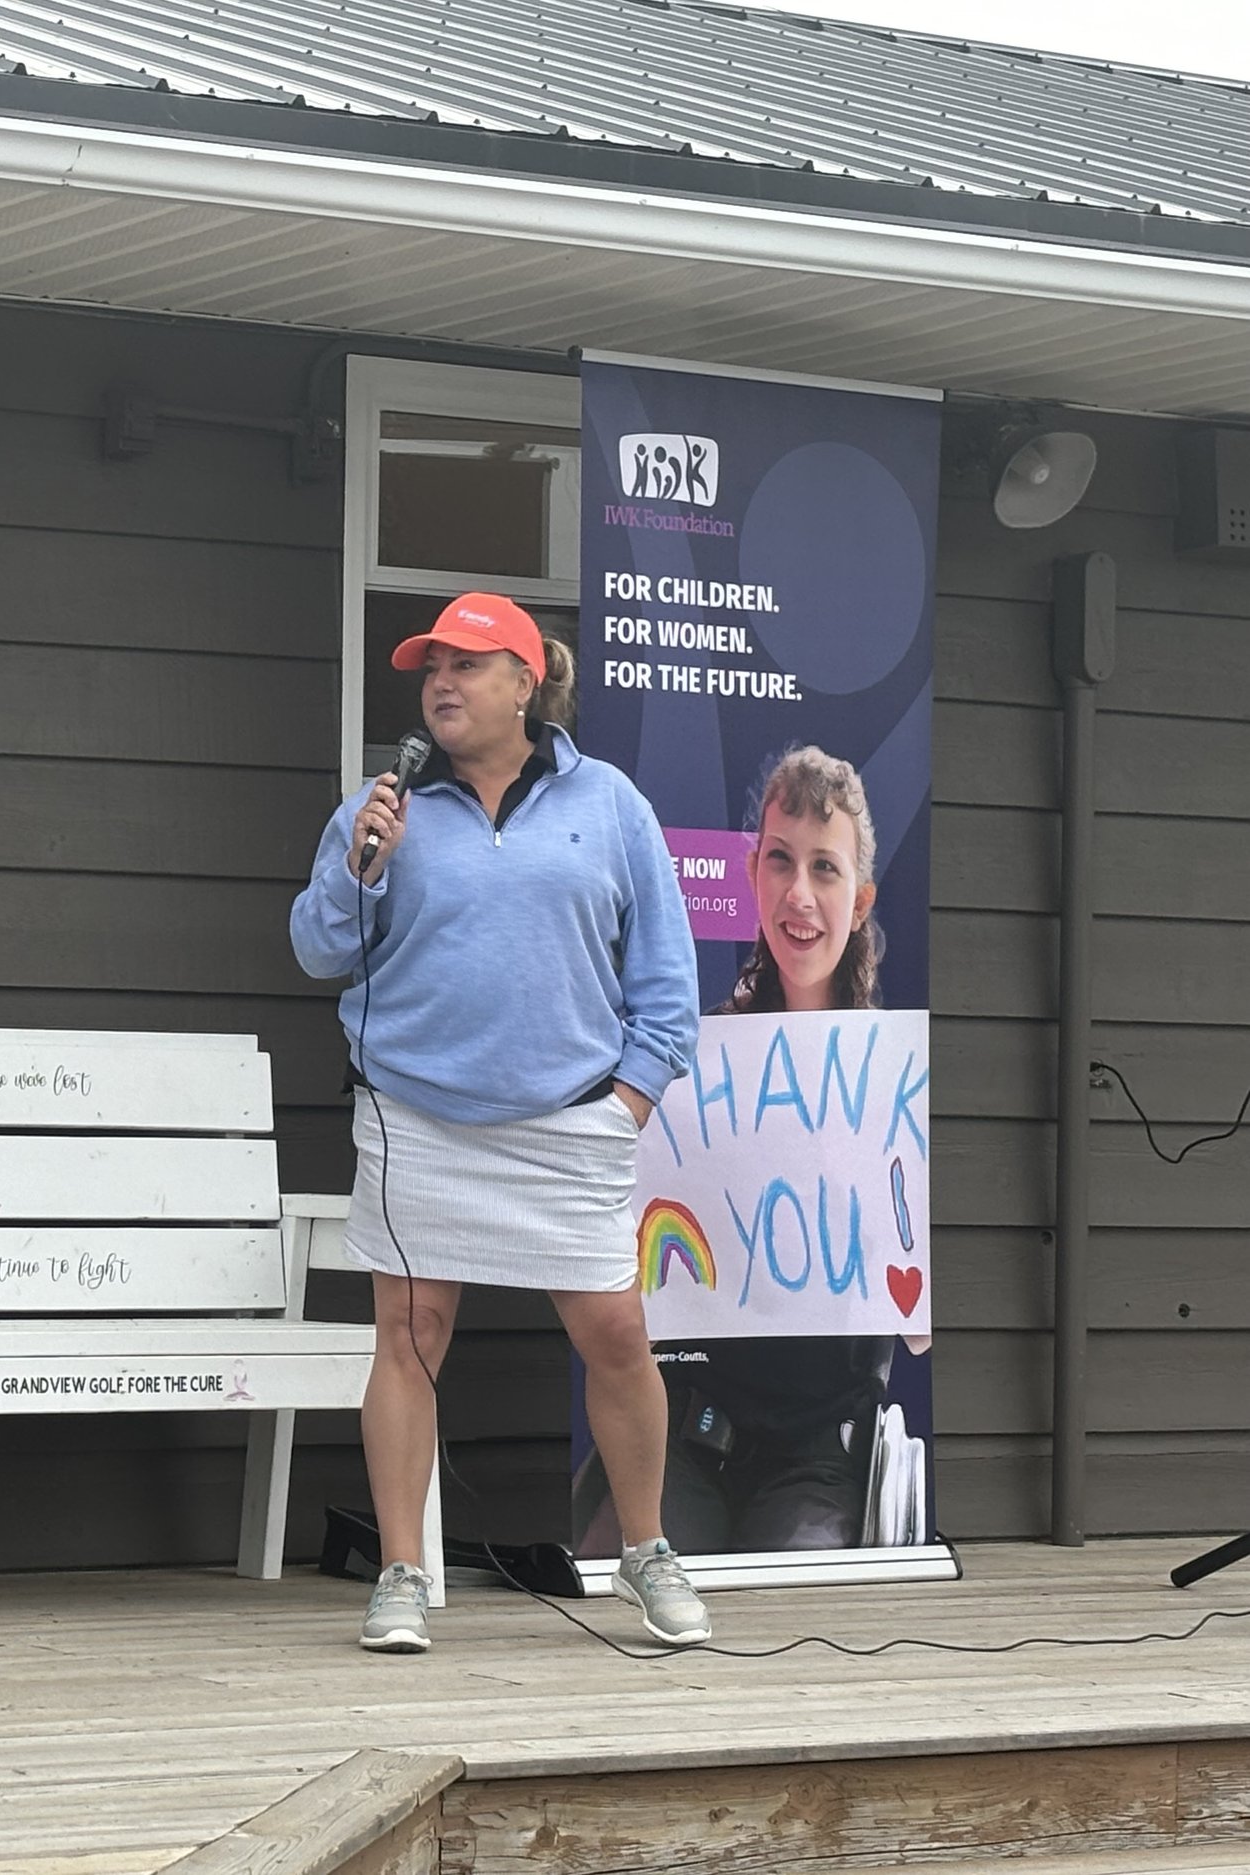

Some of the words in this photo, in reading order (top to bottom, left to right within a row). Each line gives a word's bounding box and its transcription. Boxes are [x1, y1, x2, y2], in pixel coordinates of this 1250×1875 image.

[605, 505, 643, 526] IWK
[643, 509, 735, 537] Foundation
[605, 572, 652, 602] FOR
[658, 577, 780, 613] CHILDREN.
[605, 616, 652, 646] FOR
[658, 620, 753, 655] WOMEN.
[605, 660, 652, 690] FOR
[658, 664, 701, 693] THE
[707, 669, 803, 701] FUTURE.
[683, 857, 726, 880] NOW
[683, 892, 738, 917] ion.org
[53, 1065, 92, 1096] lost
[47, 1257, 69, 1281] to
[77, 1252, 132, 1290] fight
[652, 1351, 709, 1367] pern-Coutts,
[1, 1377, 86, 1394] GRANDVIEW
[89, 1377, 125, 1394] GOLF
[128, 1376, 161, 1393] FORE
[164, 1376, 188, 1392] THE
[190, 1375, 223, 1392] CURE
